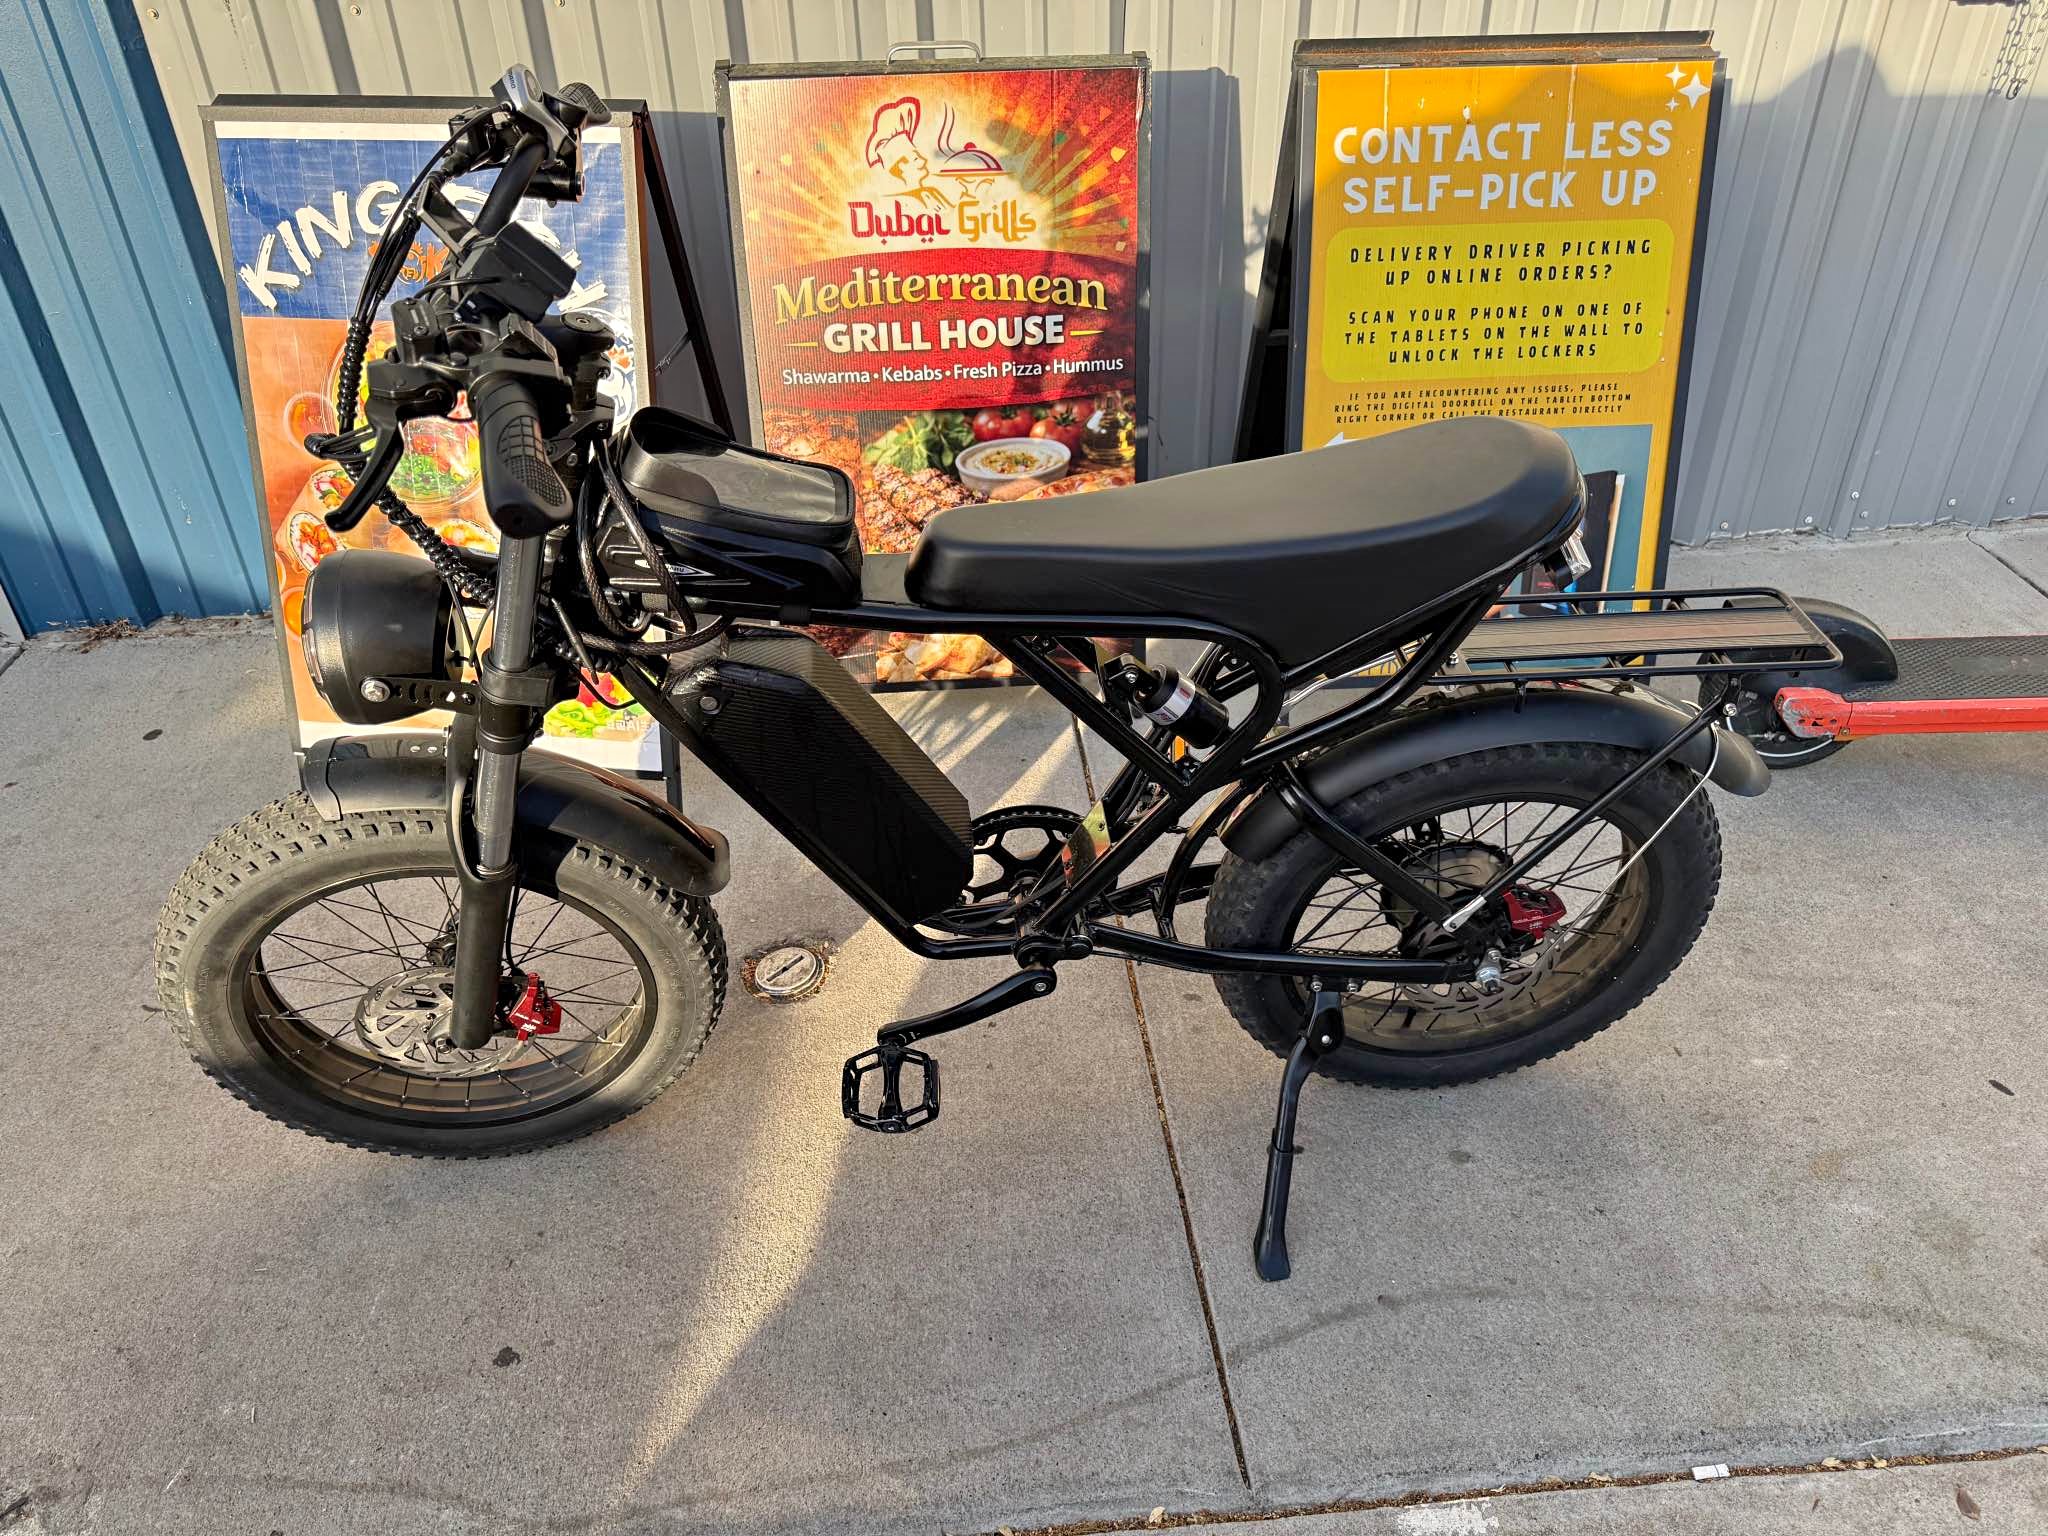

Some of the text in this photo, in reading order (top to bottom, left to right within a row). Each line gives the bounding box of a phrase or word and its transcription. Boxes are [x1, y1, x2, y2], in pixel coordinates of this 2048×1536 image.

[1333, 120, 1673, 164] CONTACT LESS
[1343, 169, 1657, 214] SELF-PICK UP
[848, 200, 1036, 244] Dubai Grills
[239, 181, 406, 310] KING
[1350, 239, 1652, 263] DELIVERY DRIVER PICKING
[1386, 264, 1612, 285] UP ONLINE ORDERS?
[773, 267, 1108, 325] Mediterranean
[1349, 302, 1642, 324] SCAN YOUR PHONE ON ONE OF
[823, 315, 1064, 353] GRILL HOUSE
[1344, 322, 1644, 345] THE TABLETS ON THE WALL TO
[1388, 344, 1596, 364] UNLOCK THE LOCKERS
[782, 358, 1124, 385] Shawarma Kebabs Fresh Pizza Hummus
[1334, 394, 1632, 413] RING THE DIGITAL DOORBELL ON THE TABLET BOTTOM
[1349, 393, 1360, 401] IF
[1367, 391, 1386, 400] YOU
[1393, 390, 1412, 399] ARE
[1419, 387, 1499, 397] ENCOUNTERING
[1506, 387, 1526, 395] ANY
[1581, 383, 1619, 392] PLEASE
[1336, 415, 1368, 424] RIGHT
[1375, 413, 1416, 422] CORNER
[1422, 412, 1435, 420] OR
[1498, 407, 1566, 416] RESTAURANT
[1572, 405, 1622, 414] DIRECTLY
